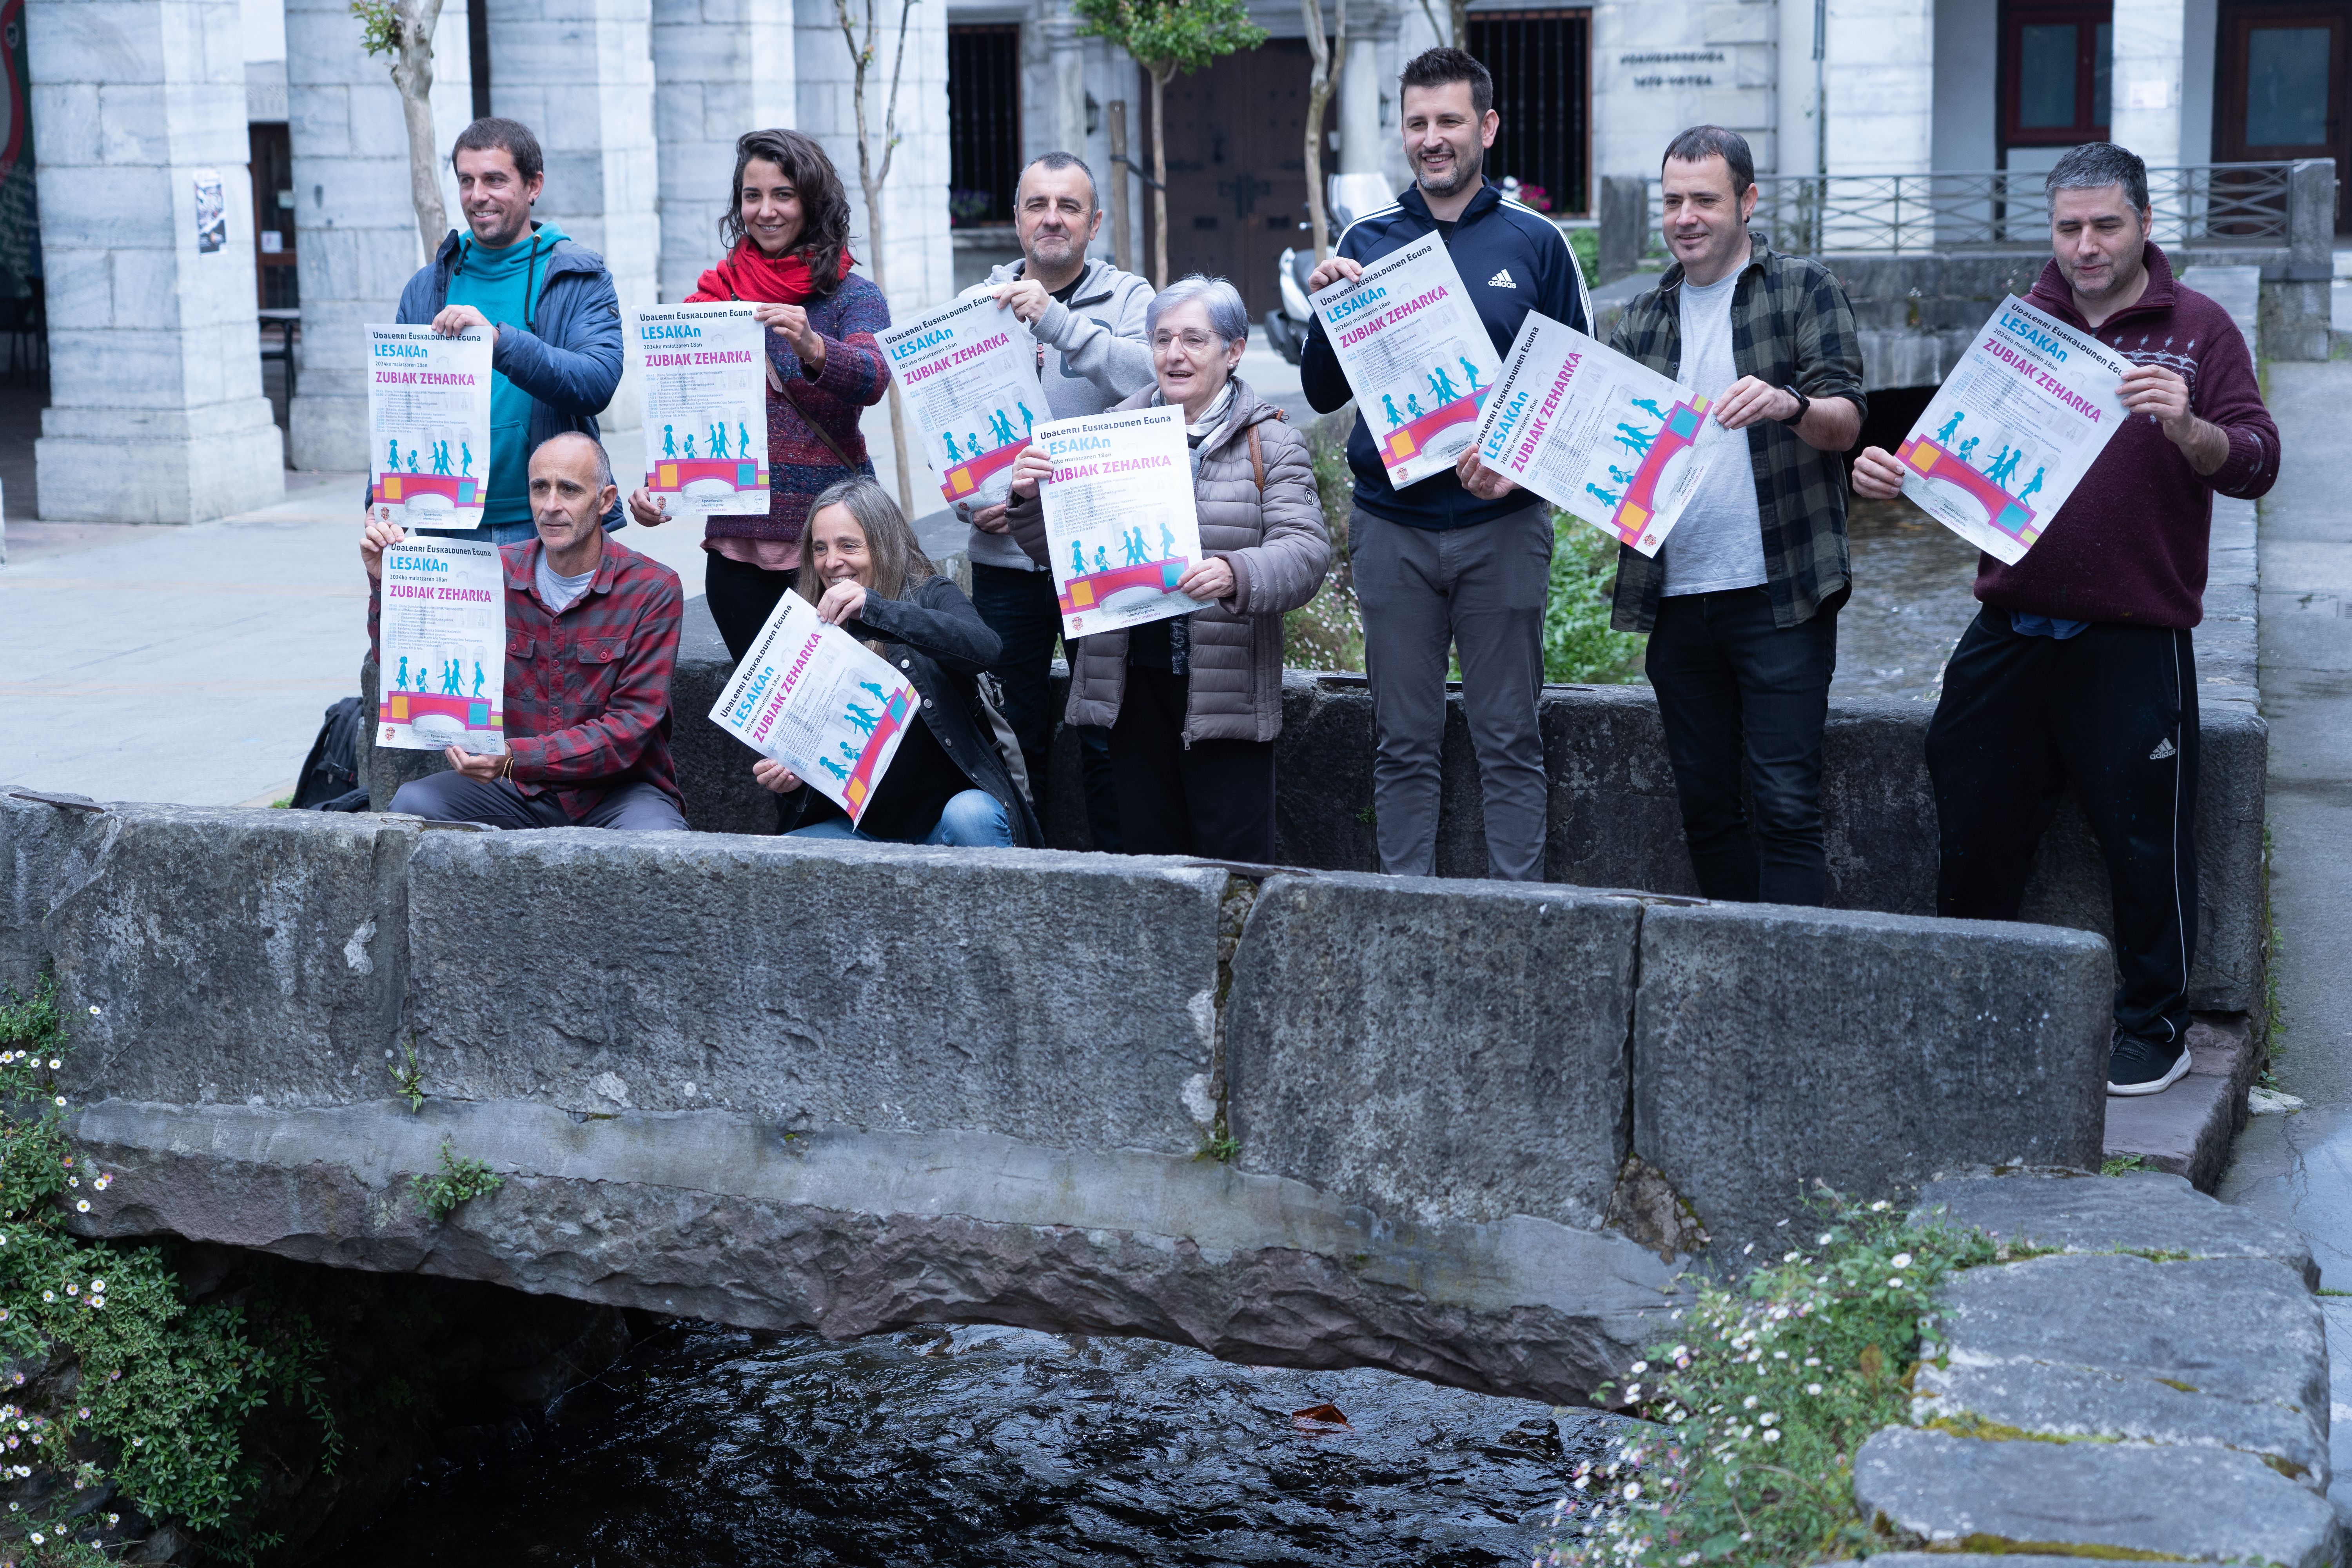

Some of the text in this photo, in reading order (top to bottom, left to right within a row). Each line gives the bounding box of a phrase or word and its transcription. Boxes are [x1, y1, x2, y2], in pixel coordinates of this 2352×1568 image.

[1488, 280, 1516, 289] adidas
[1326, 287, 1387, 323] LESAKAn
[1334, 301, 1390, 332] 2024ko maiatzaren 18an
[1339, 286, 1448, 348] ZUBIAK ZEHARKA
[641, 325, 701, 339] LESAKAn
[891, 329, 953, 361] LESAKAn
[1999, 313, 2067, 362] LESAKAn
[374, 344, 427, 358] LESAKAn
[645, 350, 751, 367] ZUBIAK ZEHARKA
[898, 359, 917, 369] 2024ko
[918, 348, 944, 361] maiatzaren
[903, 332, 1009, 385] ZUBIAK ZEHARKA
[1993, 328, 2057, 371] 2024ko maiatzaren 18an
[376, 371, 475, 385] ZUBIAK ZEHARKA
[1982, 338, 2101, 423] ZUBIAK ZEHARKA
[2108, 361, 2122, 376] Egu
[1483, 392, 1529, 459] LESAKAn
[1510, 352, 1582, 473] ZUBIAK ZEHARKA
[1042, 437, 1111, 456] ESAKAn
[1500, 399, 1538, 464] 2024ko maiatzaren 18an
[1048, 455, 1171, 485] ZUBIAK ZEHARKA
[390, 556, 448, 572] LESAKAn
[390, 585, 491, 602] ZUBIAK ZEHARKA
[731, 666, 774, 728] LESAKAn
[744, 675, 781, 733] 2024ko maiatzaren 18an
[753, 633, 822, 743] ZUBIAK ZEHARKA
